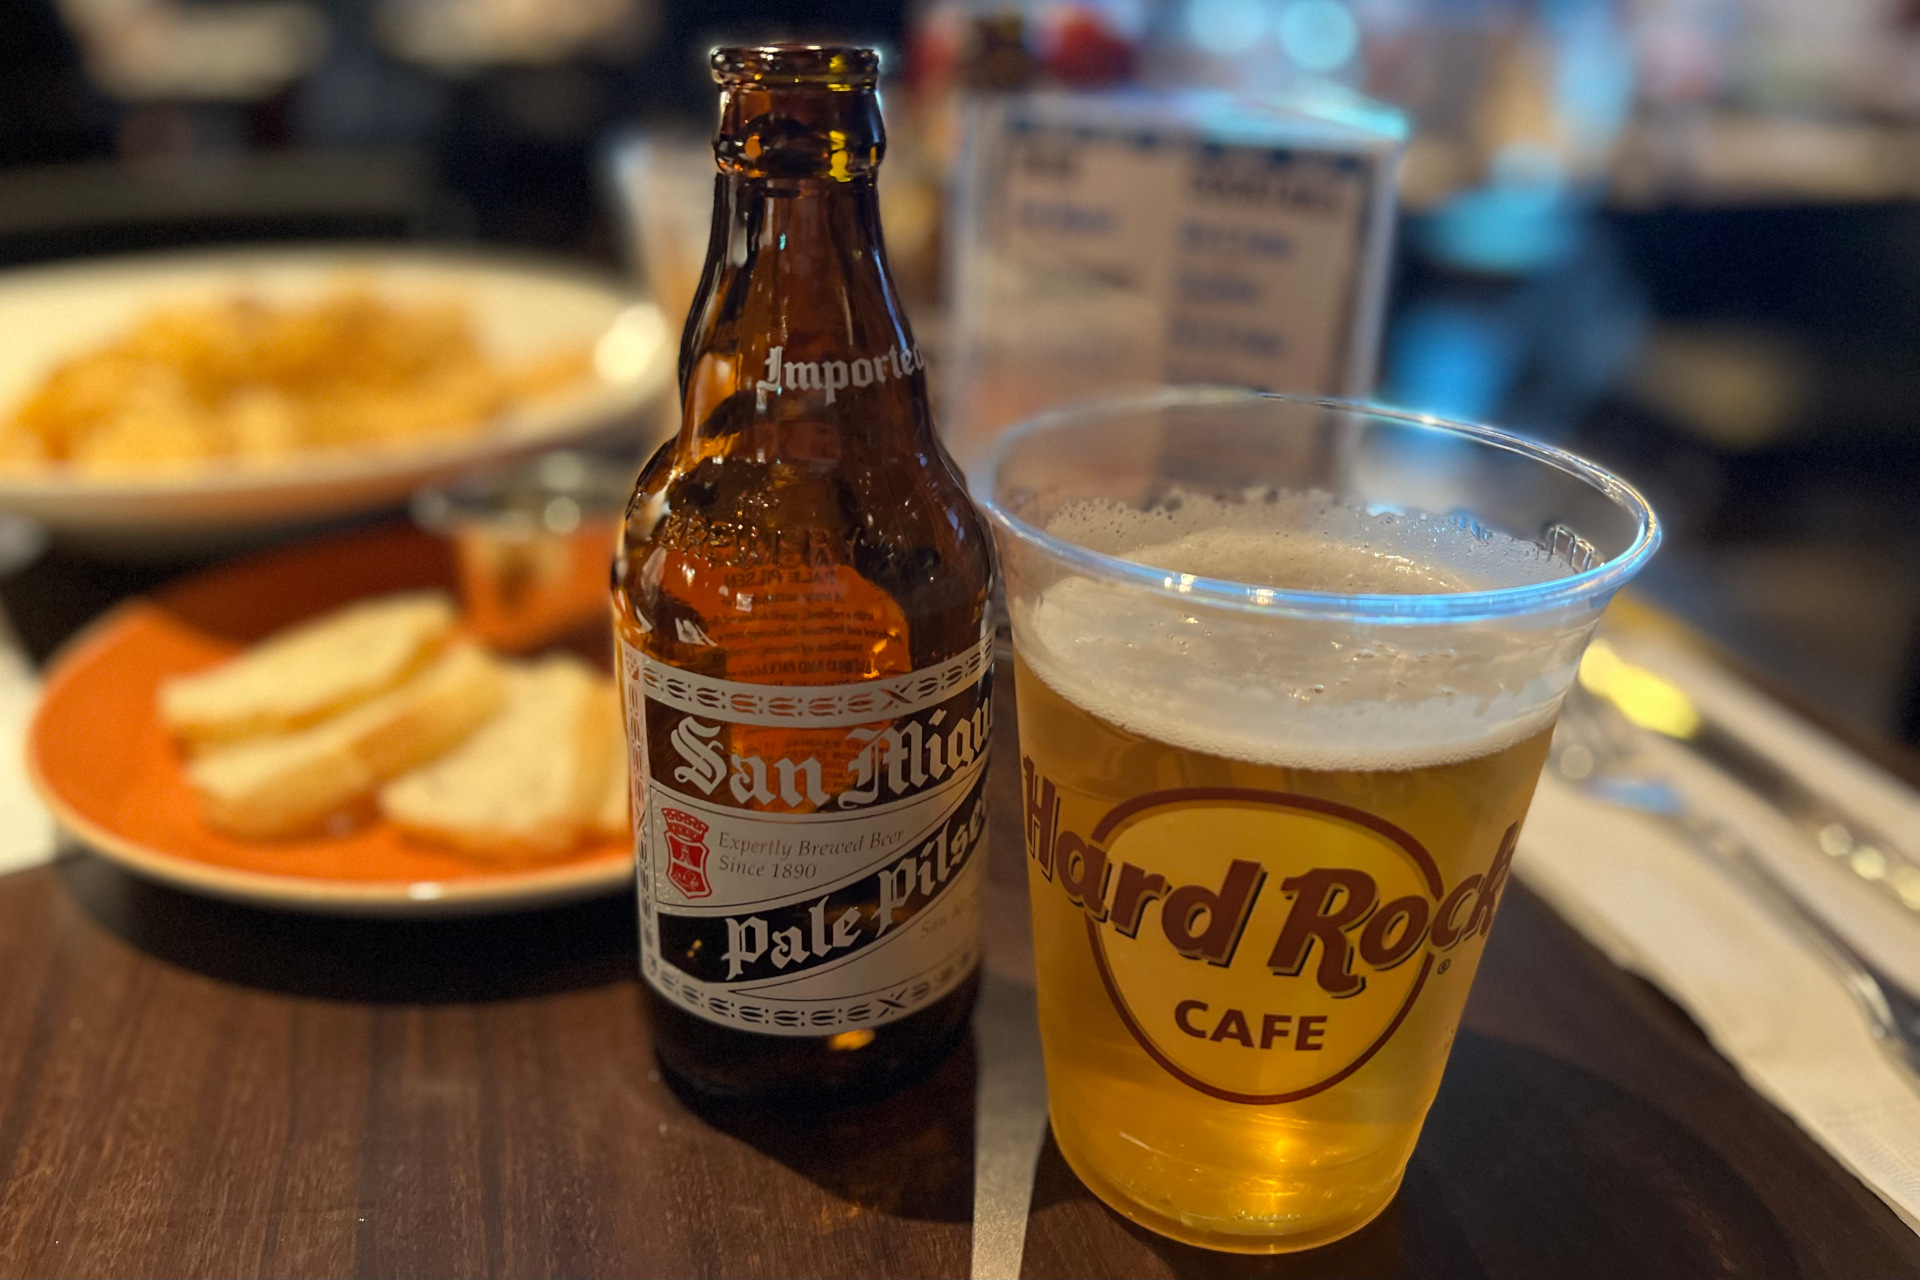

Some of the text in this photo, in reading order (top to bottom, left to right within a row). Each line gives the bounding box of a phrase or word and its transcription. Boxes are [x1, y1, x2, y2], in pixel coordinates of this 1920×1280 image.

[756, 345, 925, 406] Imported
[670, 715, 831, 808] San
[838, 697, 993, 810] Migu
[718, 830, 905, 861] Expertly Brewed Beer
[719, 855, 817, 880] Since 1890
[721, 793, 987, 980] Pale Pilse
[1023, 755, 1519, 998] Hard Rock
[1174, 999, 1329, 1051] CAFE
